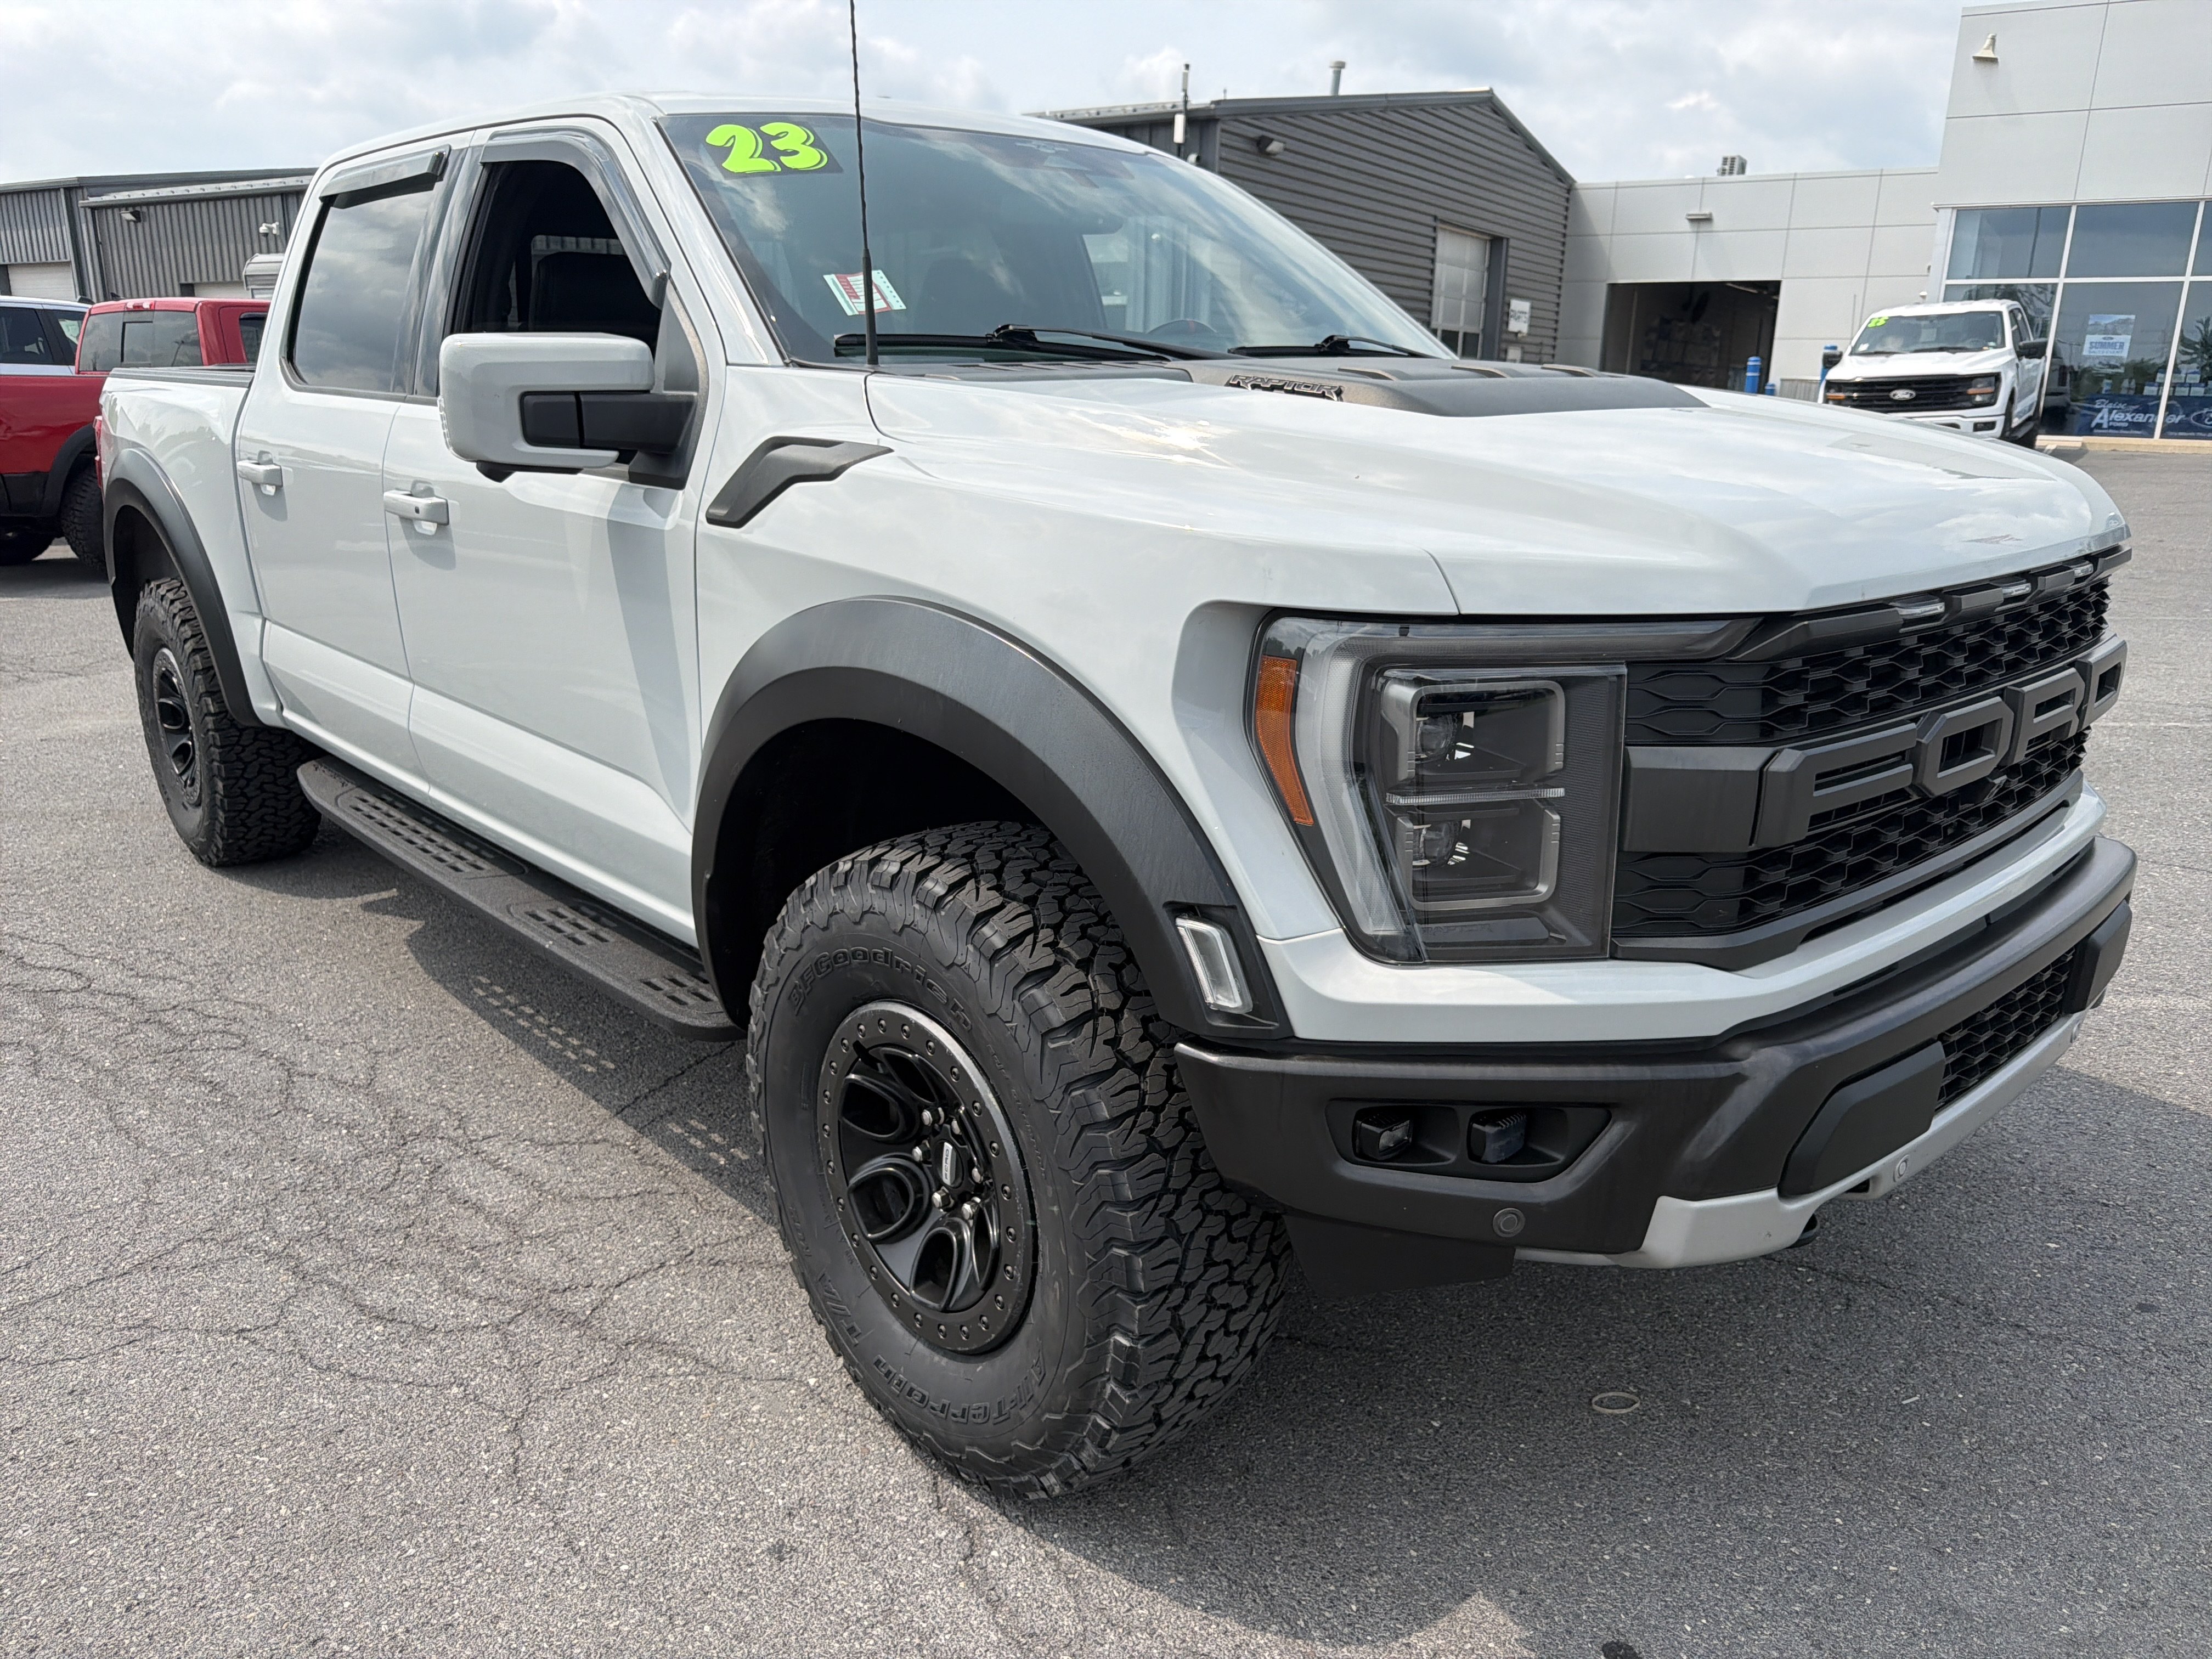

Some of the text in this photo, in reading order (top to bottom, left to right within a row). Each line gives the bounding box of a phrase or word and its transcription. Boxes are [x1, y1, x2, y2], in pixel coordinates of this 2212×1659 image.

[706, 122, 828, 173] 23
[2089, 341, 2124, 349] SUMMER
[1228, 374, 1342, 402] RAPTOR
[1757, 634, 2128, 845] FORD
[788, 946, 973, 1031] BFGoodrich
